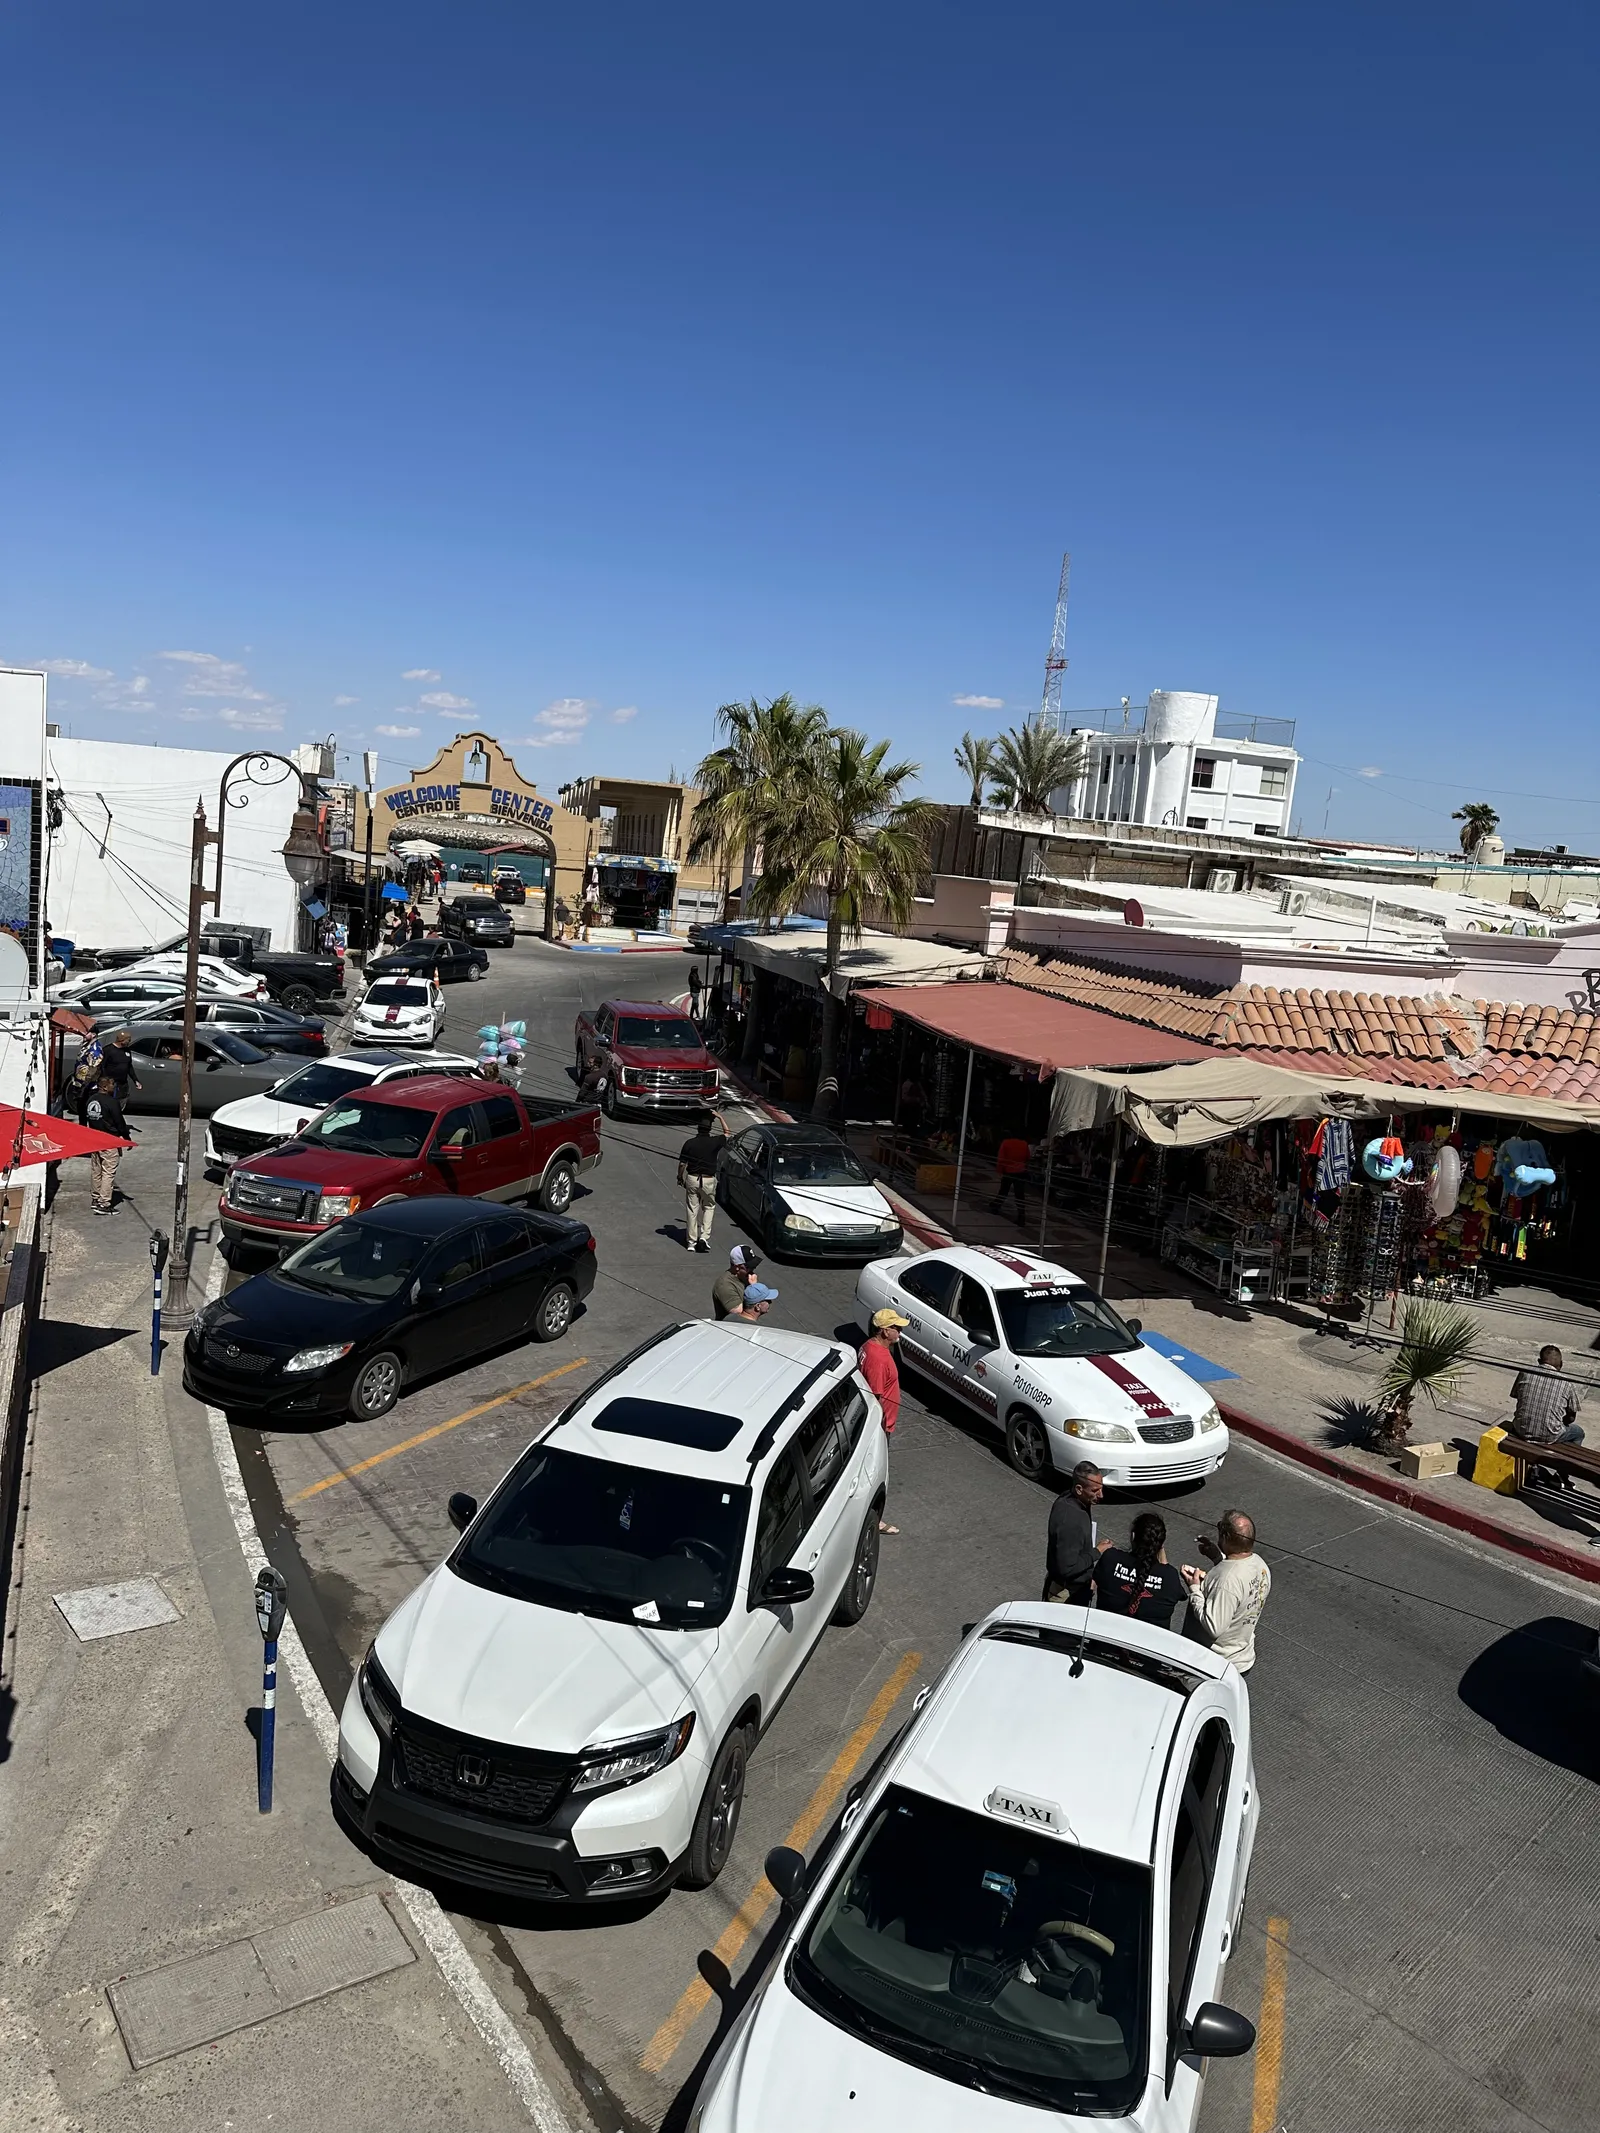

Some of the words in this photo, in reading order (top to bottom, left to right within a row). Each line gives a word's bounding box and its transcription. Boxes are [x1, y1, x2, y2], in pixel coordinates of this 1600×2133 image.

[384, 785, 460, 811] WELCOME
[491, 788, 554, 821] CENTER
[395, 801, 443, 819] CENTRO
[445, 801, 460, 811] DE
[490, 803, 553, 835] BIENVENIDA
[1023, 1289, 1049, 1298] Juan
[1049, 1287, 1071, 1296] 3:16
[951, 1344, 971, 1367] TAXI
[1013, 1375, 1053, 1408] P010108PP
[1123, 1382, 1145, 1390] TAXI
[1115, 1562, 1129, 1575] I'm
[1129, 1568, 1137, 1578] A
[1145, 1575, 1163, 1584] urse
[1000, 1797, 1053, 1824] TAXI
